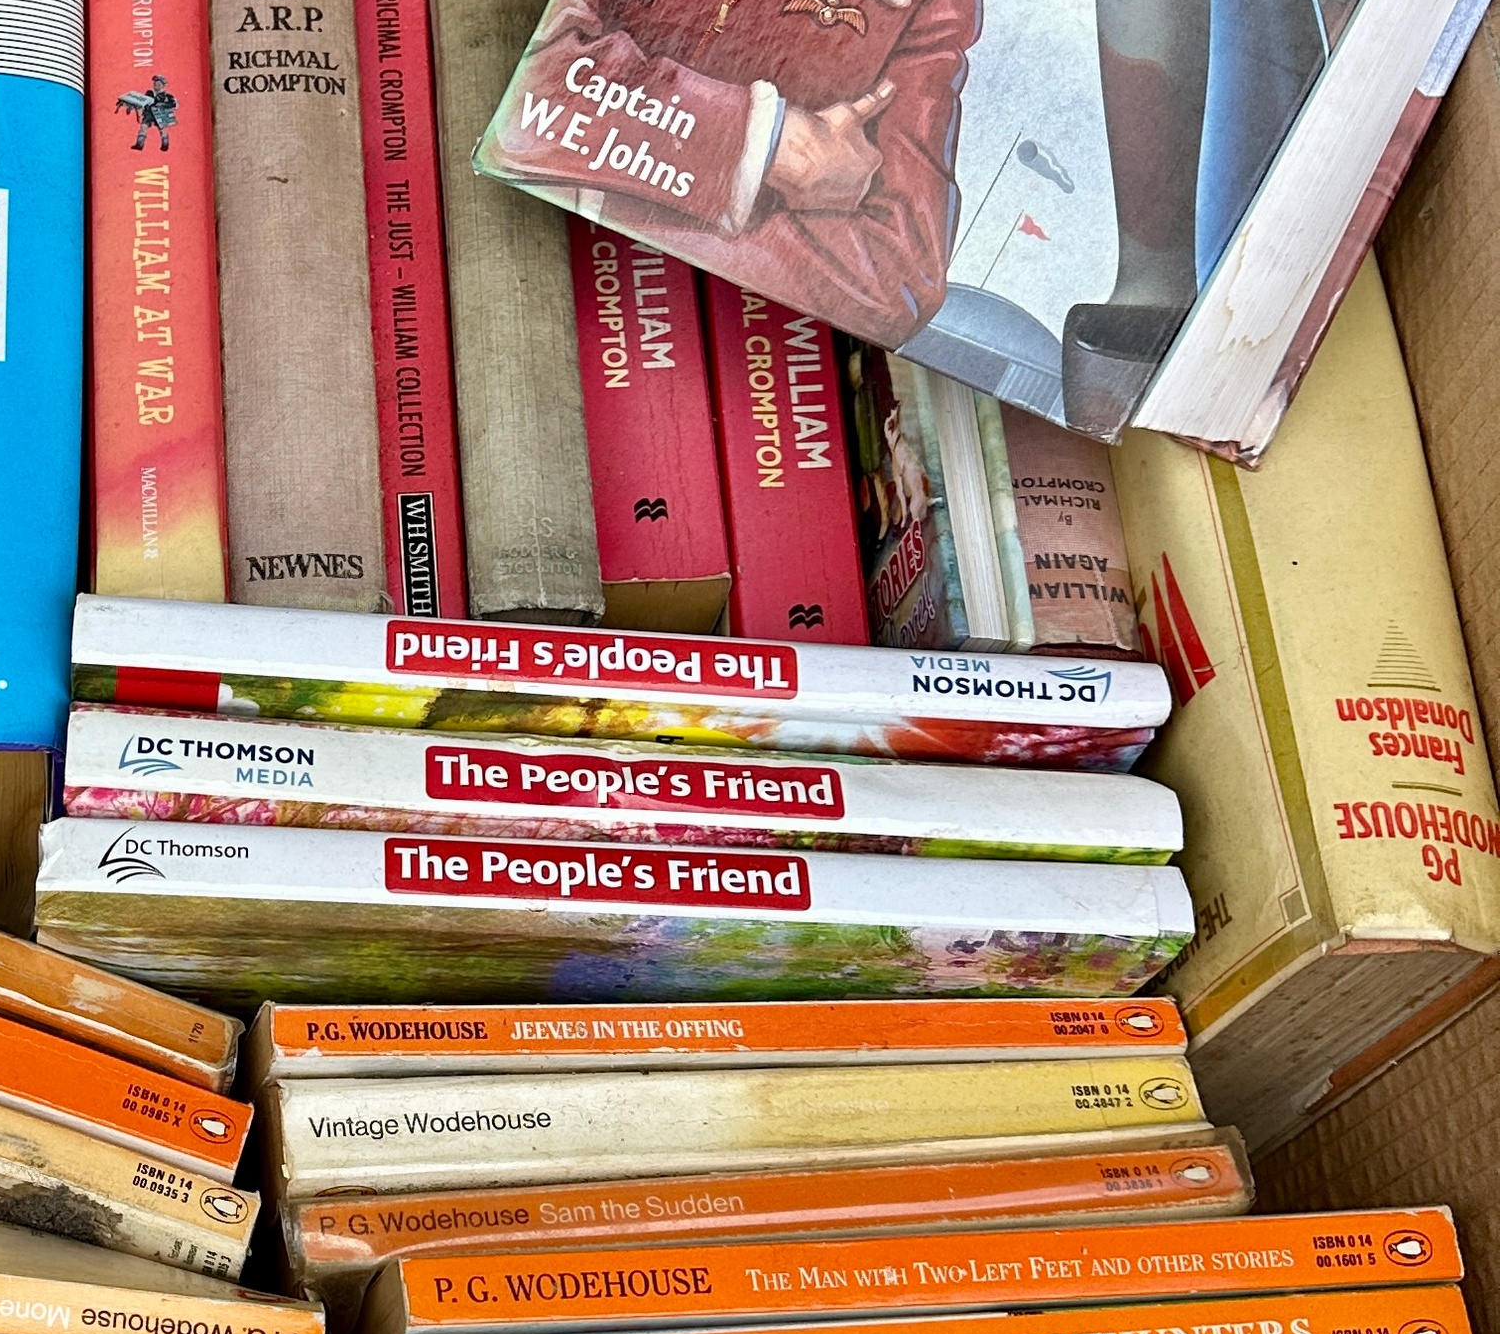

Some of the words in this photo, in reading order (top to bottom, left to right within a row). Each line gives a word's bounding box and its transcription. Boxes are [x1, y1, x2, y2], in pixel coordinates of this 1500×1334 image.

[237, 6, 322, 33] A.R.P.
[229, 50, 339, 70] RICHMAL
[223, 74, 346, 96] CROMPTON
[565, 57, 696, 139] Captain
[379, 69, 408, 162] CROMPTON
[589, 128, 695, 197] Johns
[386, 179, 410, 213] THE
[132, 164, 171, 295] WILLIAM
[134, 305, 173, 347] AT
[392, 283, 419, 362] WILLIAM
[592, 240, 631, 389] CROMPTON
[136, 357, 175, 426] WAR
[784, 316, 832, 469] WILLIAM
[395, 366, 427, 478] COLLECTION
[746, 335, 785, 489] CROMPTON
[141, 466, 159, 559] MACMILLAN
[1017, 494, 1101, 511] RICHMAL
[246, 553, 363, 582] NEWNES
[1035, 554, 1109, 572] AGAIN
[394, 631, 521, 671] Friend
[910, 655, 990, 673] MEDIA
[714, 652, 788, 690] The
[912, 674, 1053, 701] THOMSON
[1059, 683, 1096, 703] DC
[1336, 697, 1474, 745] Donaldson
[137, 737, 174, 756] DC
[179, 739, 315, 766] THOMSON
[1371, 732, 1464, 776] Frances
[236, 767, 314, 787] MEDIA
[435, 754, 509, 790] The
[703, 769, 835, 807] Friend
[125, 839, 153, 856] DC
[156, 839, 250, 859] Thomson
[393, 846, 469, 882] The
[668, 860, 802, 897] Friend
[348, 1021, 488, 1040] WODEHOUSE
[510, 1021, 588, 1040] JEEVES
[618, 1021, 660, 1038] THE
[665, 1018, 744, 1039] OFFING
[308, 1116, 400, 1139] Vintage
[404, 1111, 552, 1134] Wodehouse
[378, 1206, 529, 1233] Wodehouse
[539, 1202, 597, 1225] Sam
[600, 1198, 642, 1221] the
[644, 1194, 745, 1218] Sudden
[504, 1268, 713, 1301] WODEHOUSE
